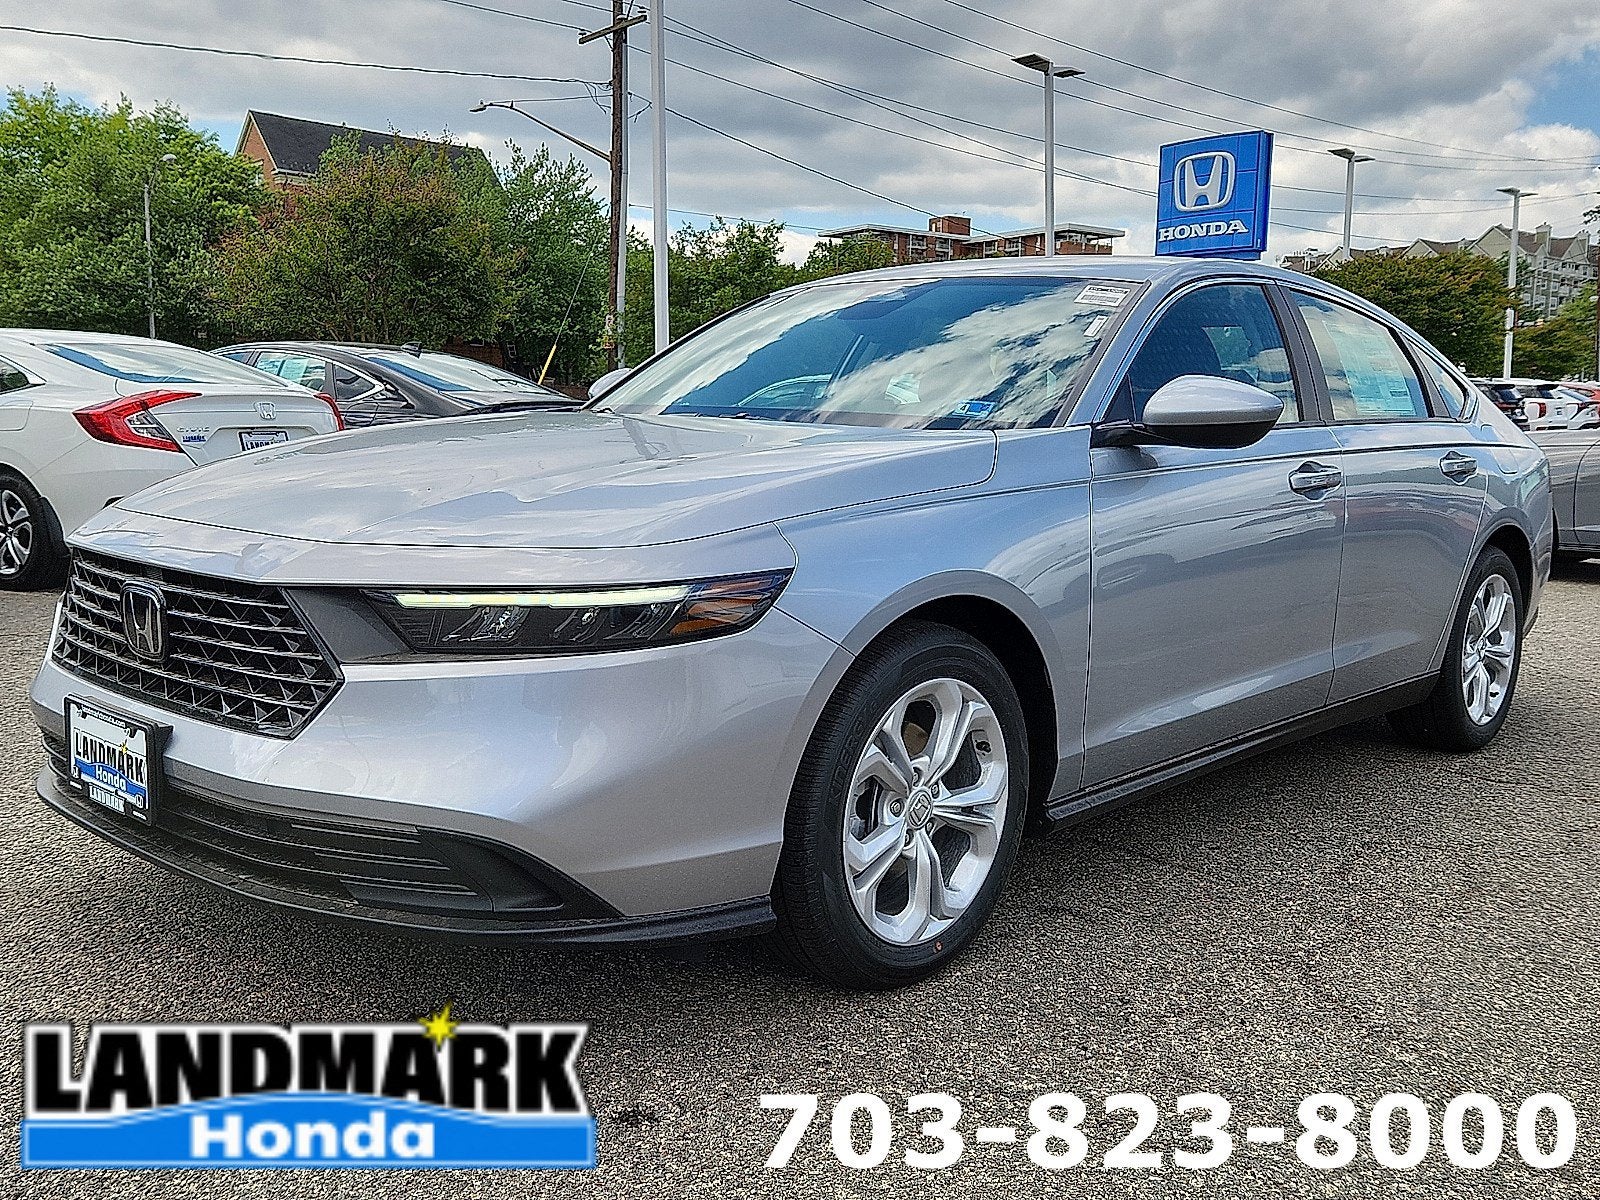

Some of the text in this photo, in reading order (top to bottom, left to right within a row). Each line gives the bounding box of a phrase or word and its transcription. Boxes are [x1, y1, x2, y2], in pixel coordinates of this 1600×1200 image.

[1158, 219, 1249, 242] HONDA
[75, 731, 146, 785] LANDMARK
[95, 764, 127, 791] Honda
